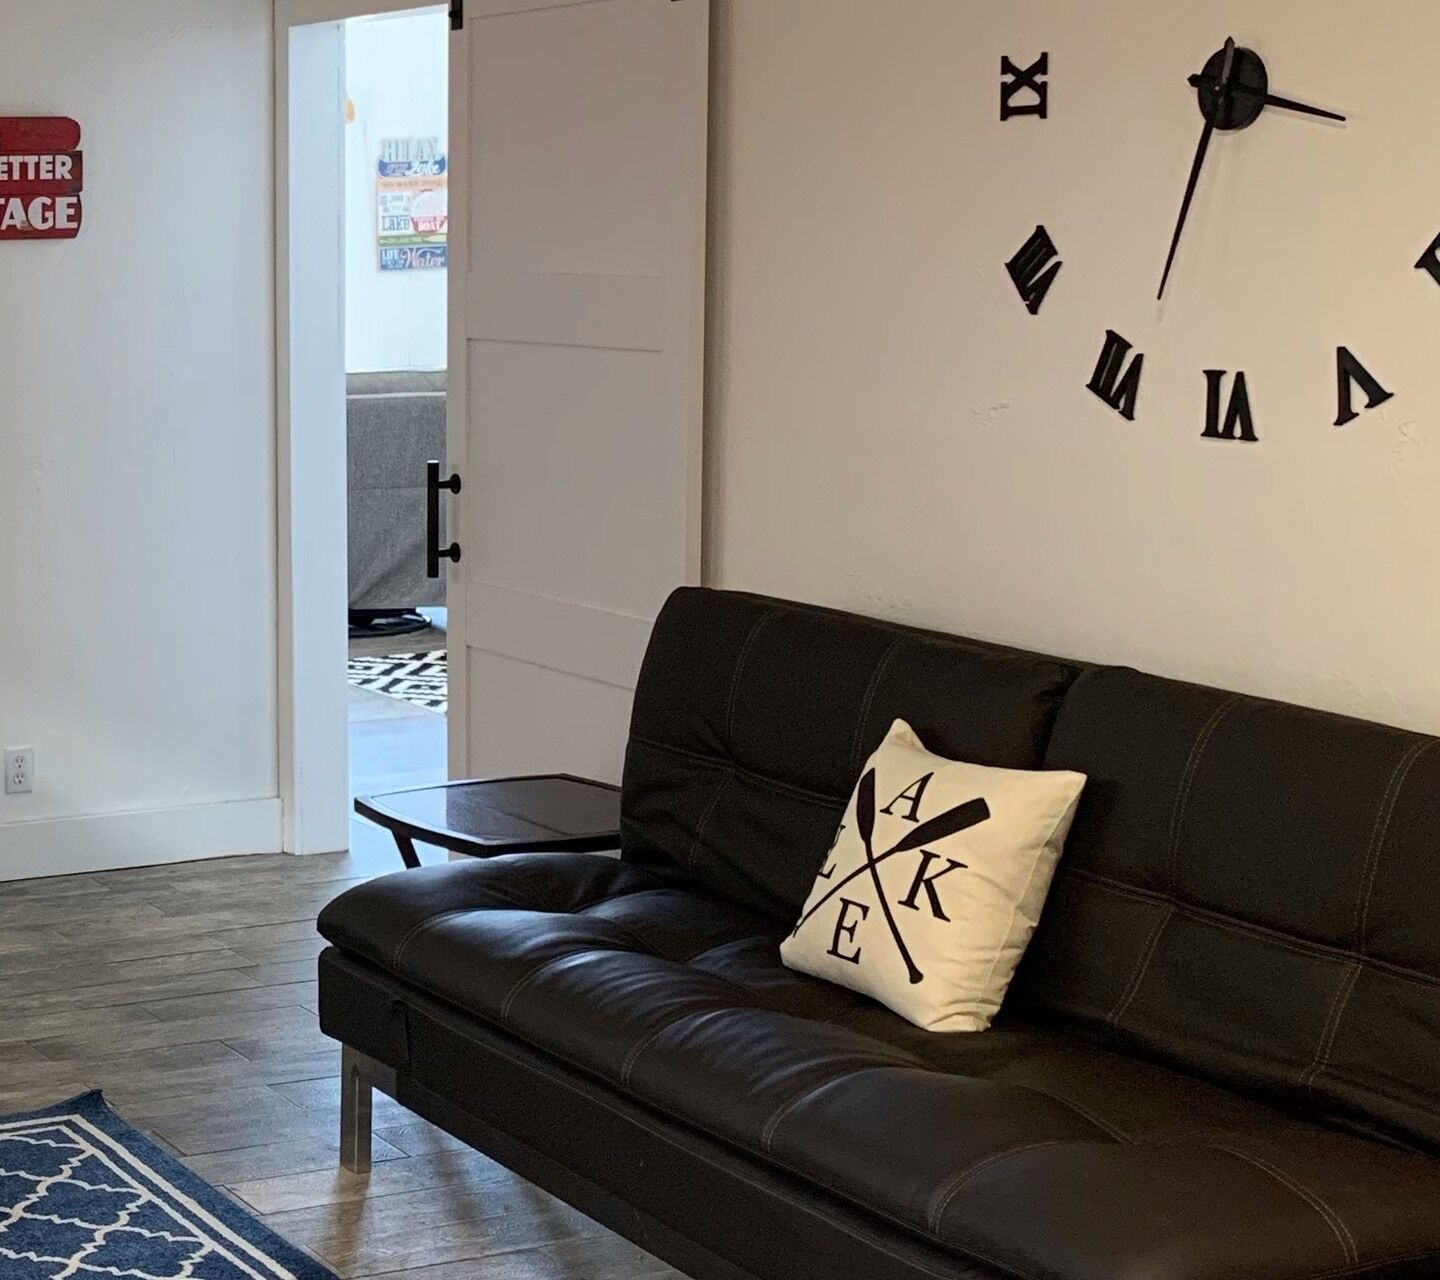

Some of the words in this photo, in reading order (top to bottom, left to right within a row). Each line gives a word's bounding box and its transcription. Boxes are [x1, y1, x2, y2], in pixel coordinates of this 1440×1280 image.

[999, 51, 1049, 122] IX
[1200, 369, 1259, 442] VI
[1333, 346, 1395, 426] V
